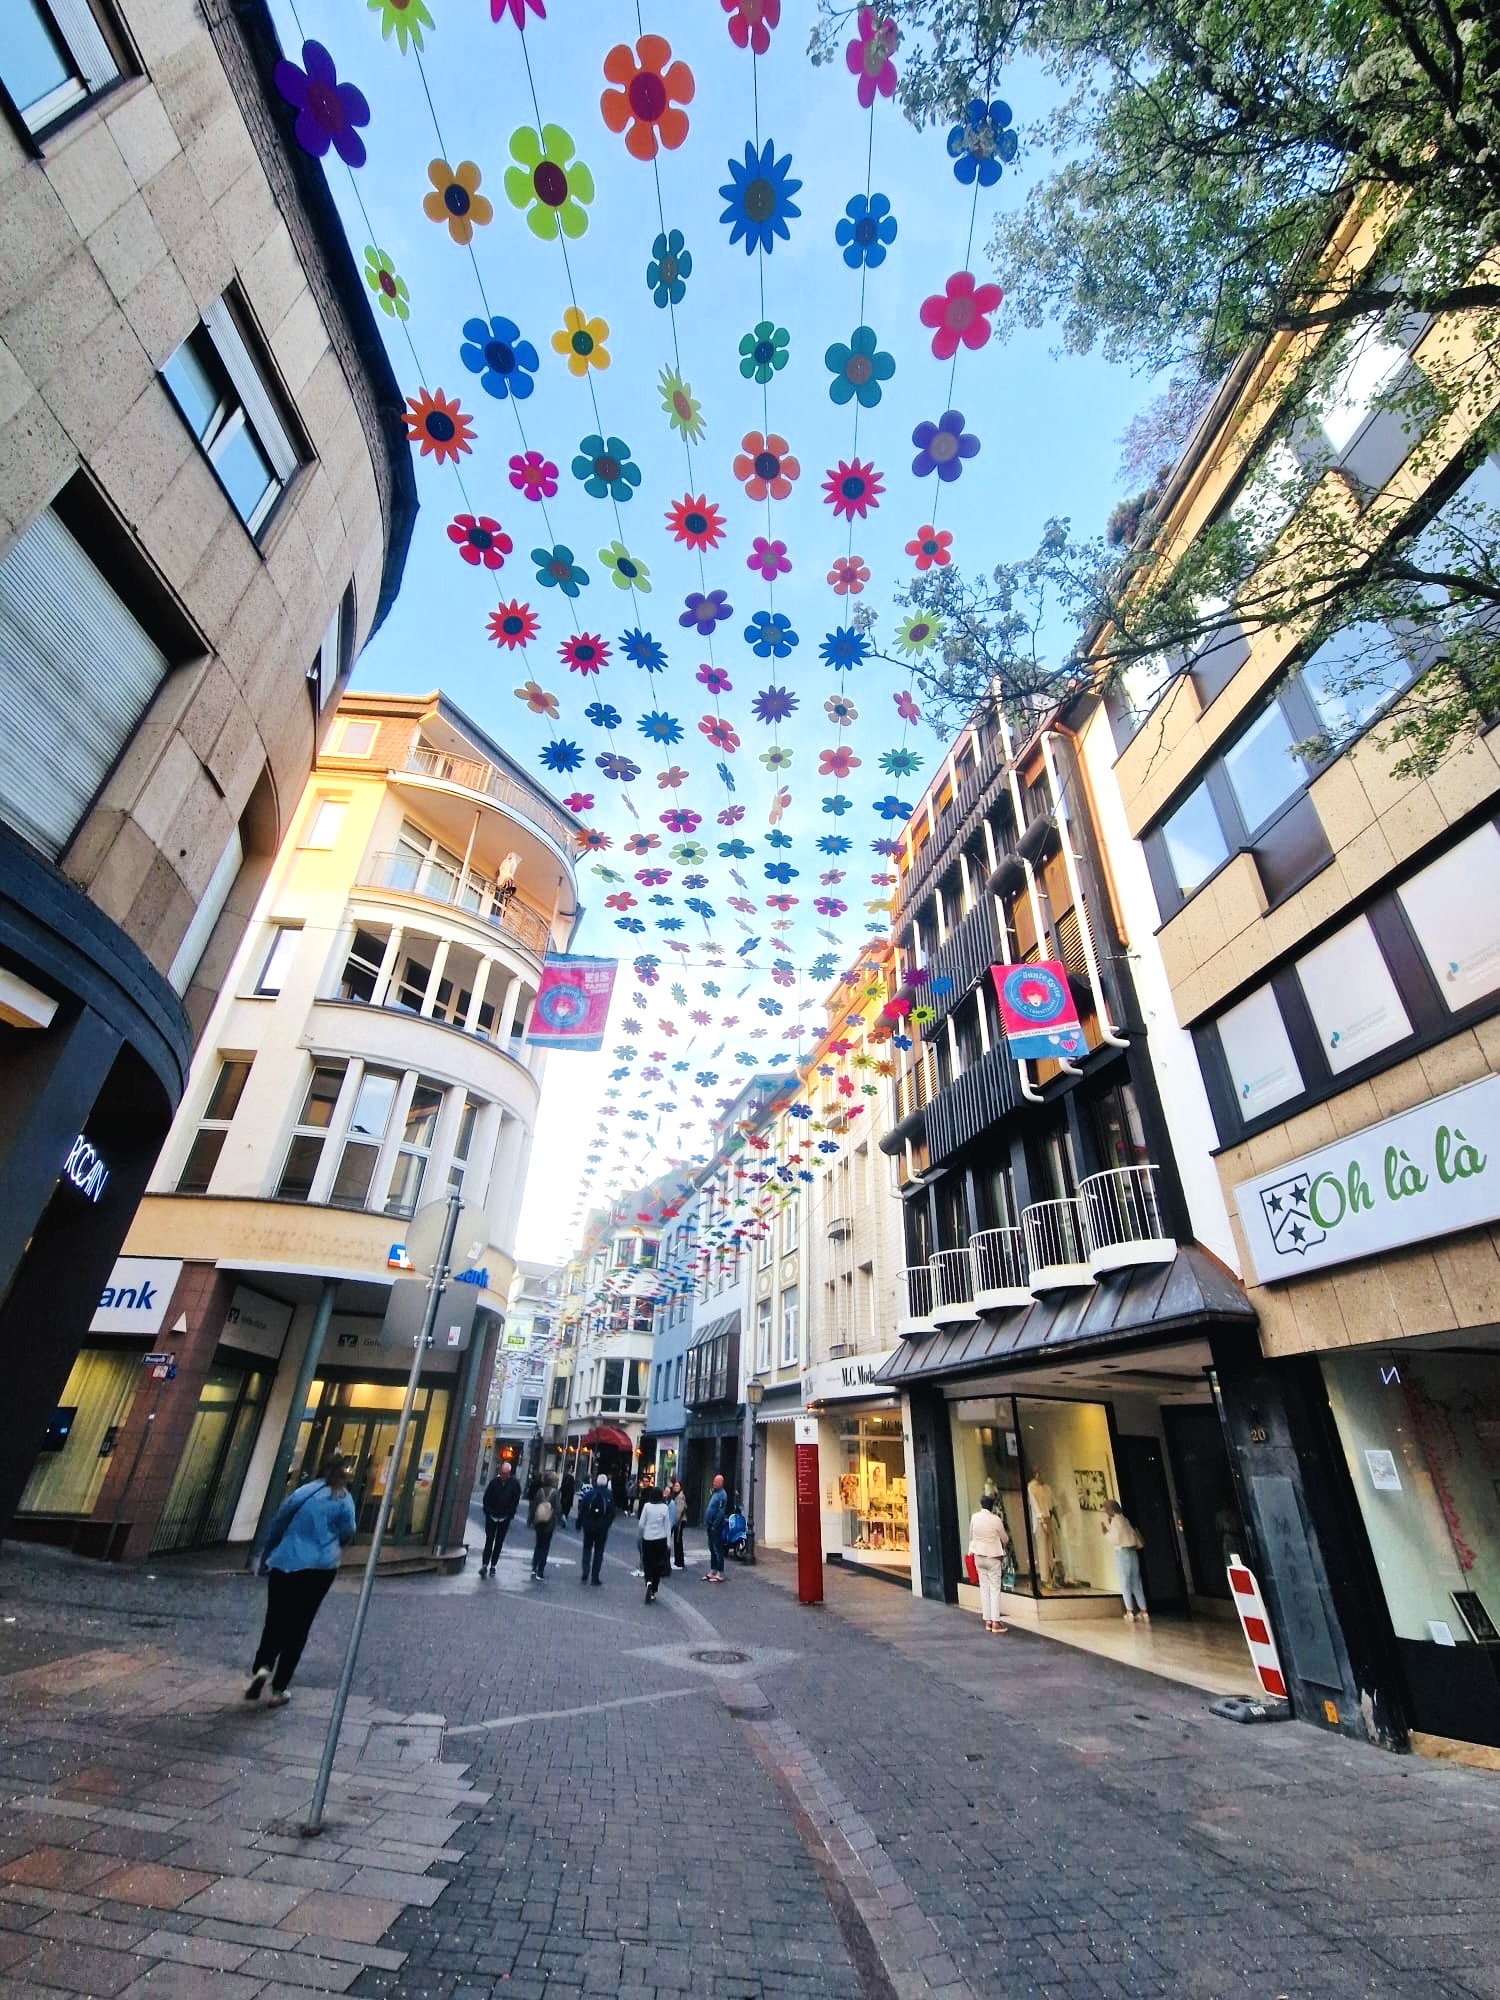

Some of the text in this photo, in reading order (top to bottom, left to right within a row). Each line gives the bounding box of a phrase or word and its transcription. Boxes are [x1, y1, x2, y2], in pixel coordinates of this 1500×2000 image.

[1309, 1125, 1487, 1229] Oh là là
[1250, 1429, 1266, 1441] 20
